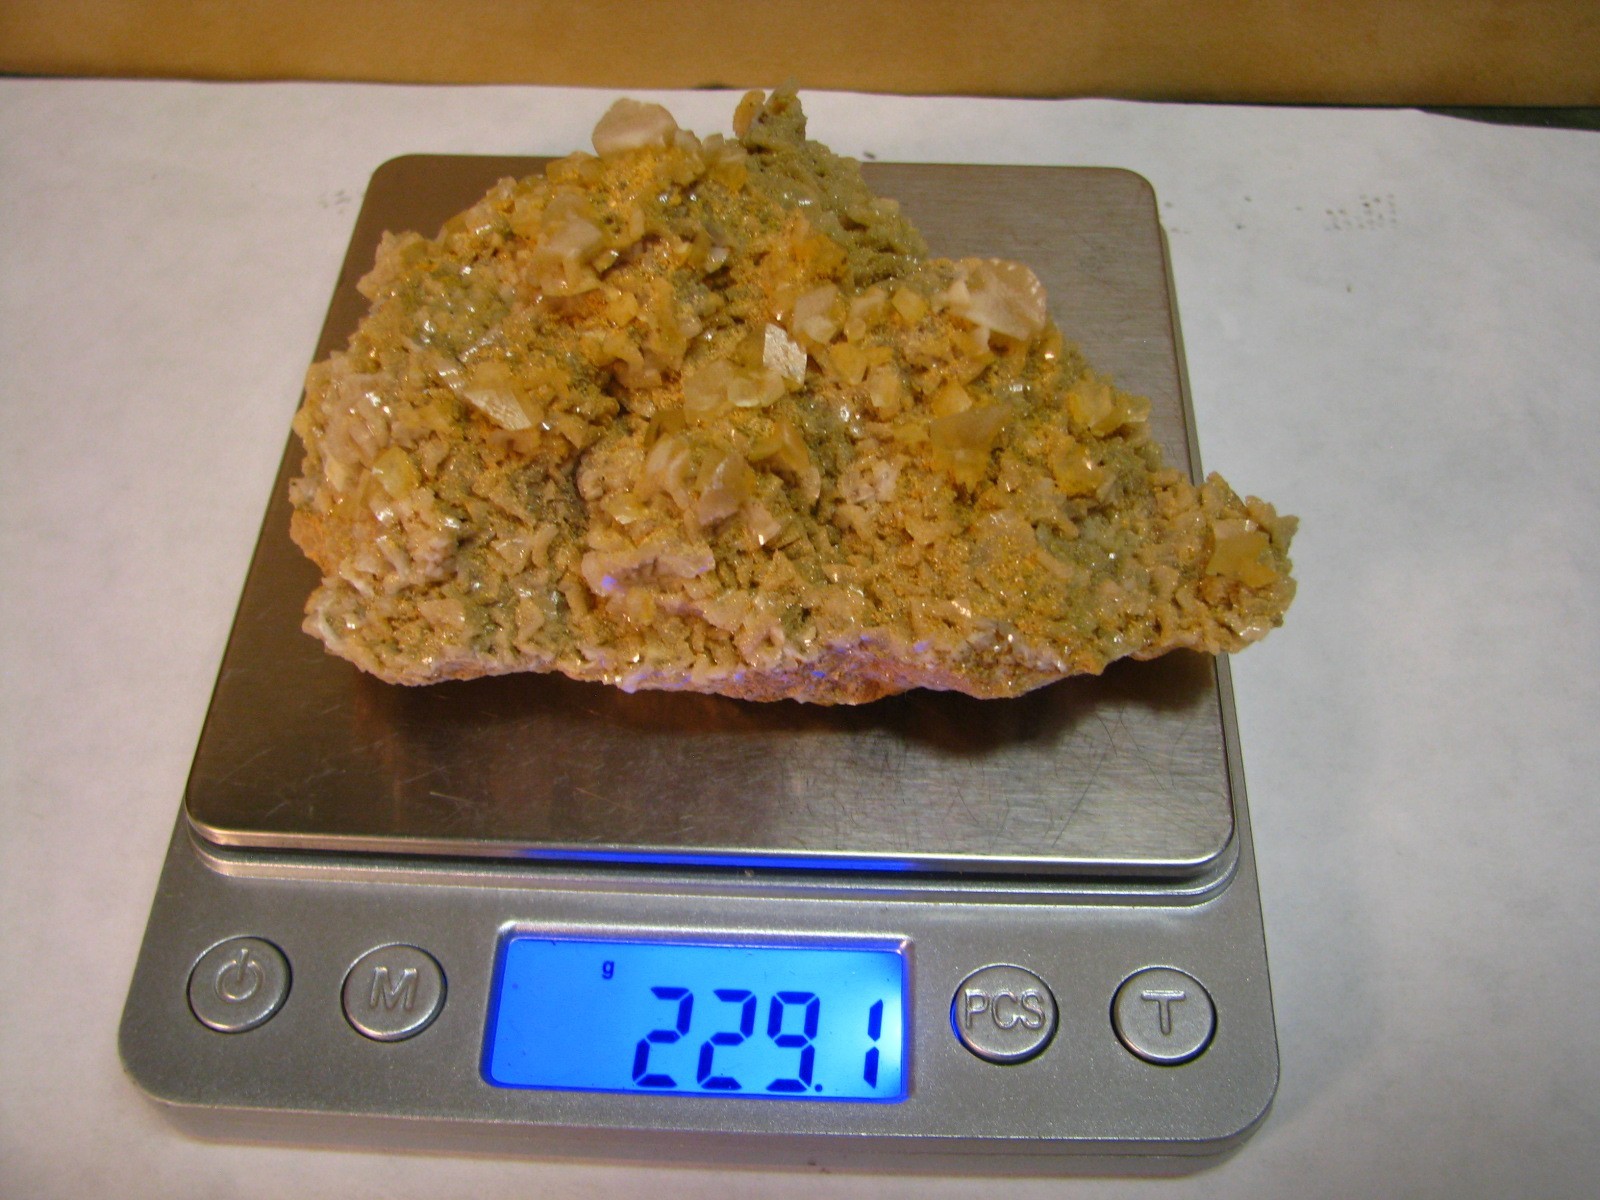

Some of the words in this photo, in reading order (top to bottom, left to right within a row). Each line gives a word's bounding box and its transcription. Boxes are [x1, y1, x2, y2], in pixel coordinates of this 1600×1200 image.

[370, 966, 418, 1011] M
[601, 959, 615, 979] g
[964, 988, 1046, 1031] PCS
[1140, 989, 1187, 1036] T
[631, 986, 884, 1093] 229.1
